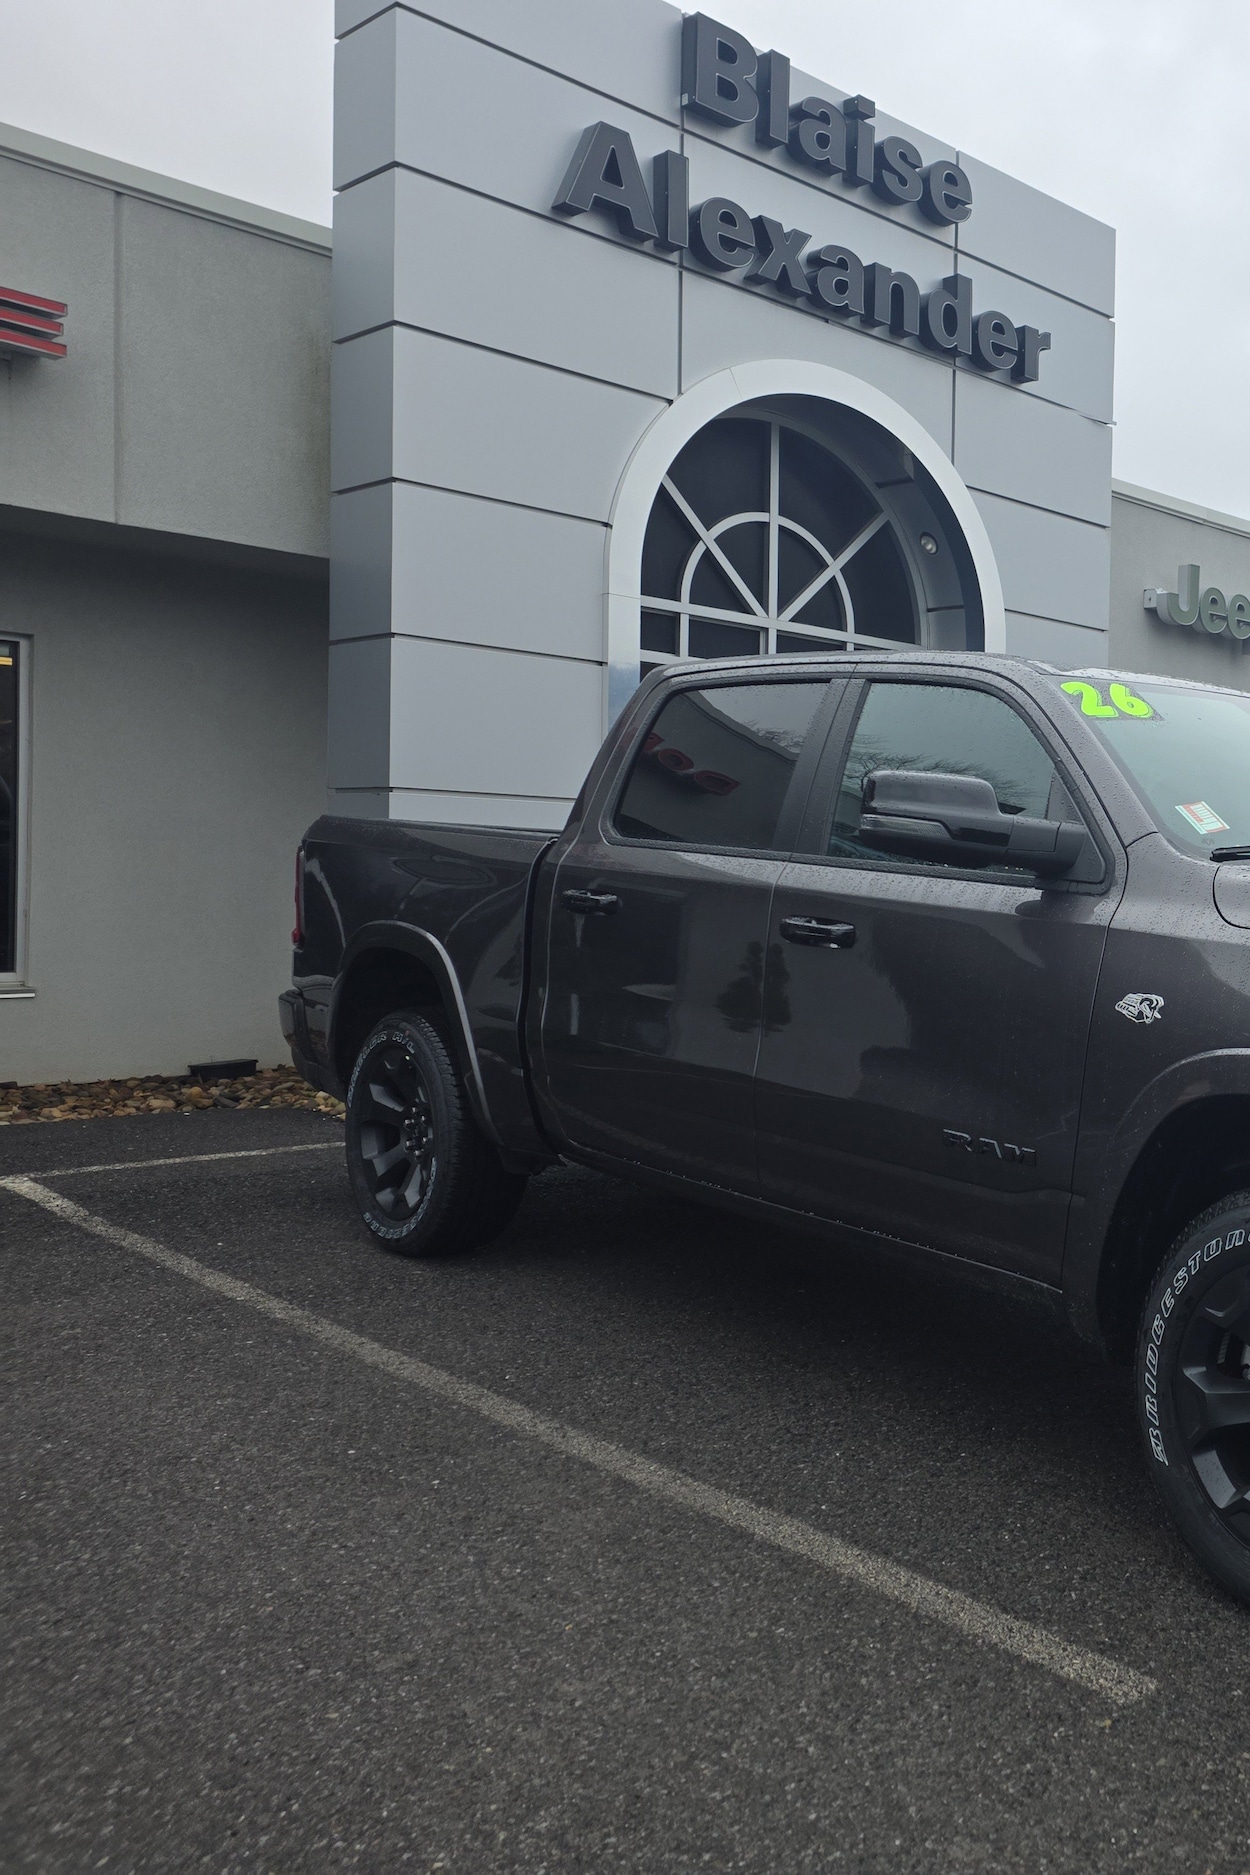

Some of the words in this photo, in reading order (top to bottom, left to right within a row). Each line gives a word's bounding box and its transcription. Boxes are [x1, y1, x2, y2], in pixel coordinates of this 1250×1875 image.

[681, 11, 973, 226] Blaise
[552, 121, 1052, 383] Alexander
[1060, 681, 1155, 718] 26
